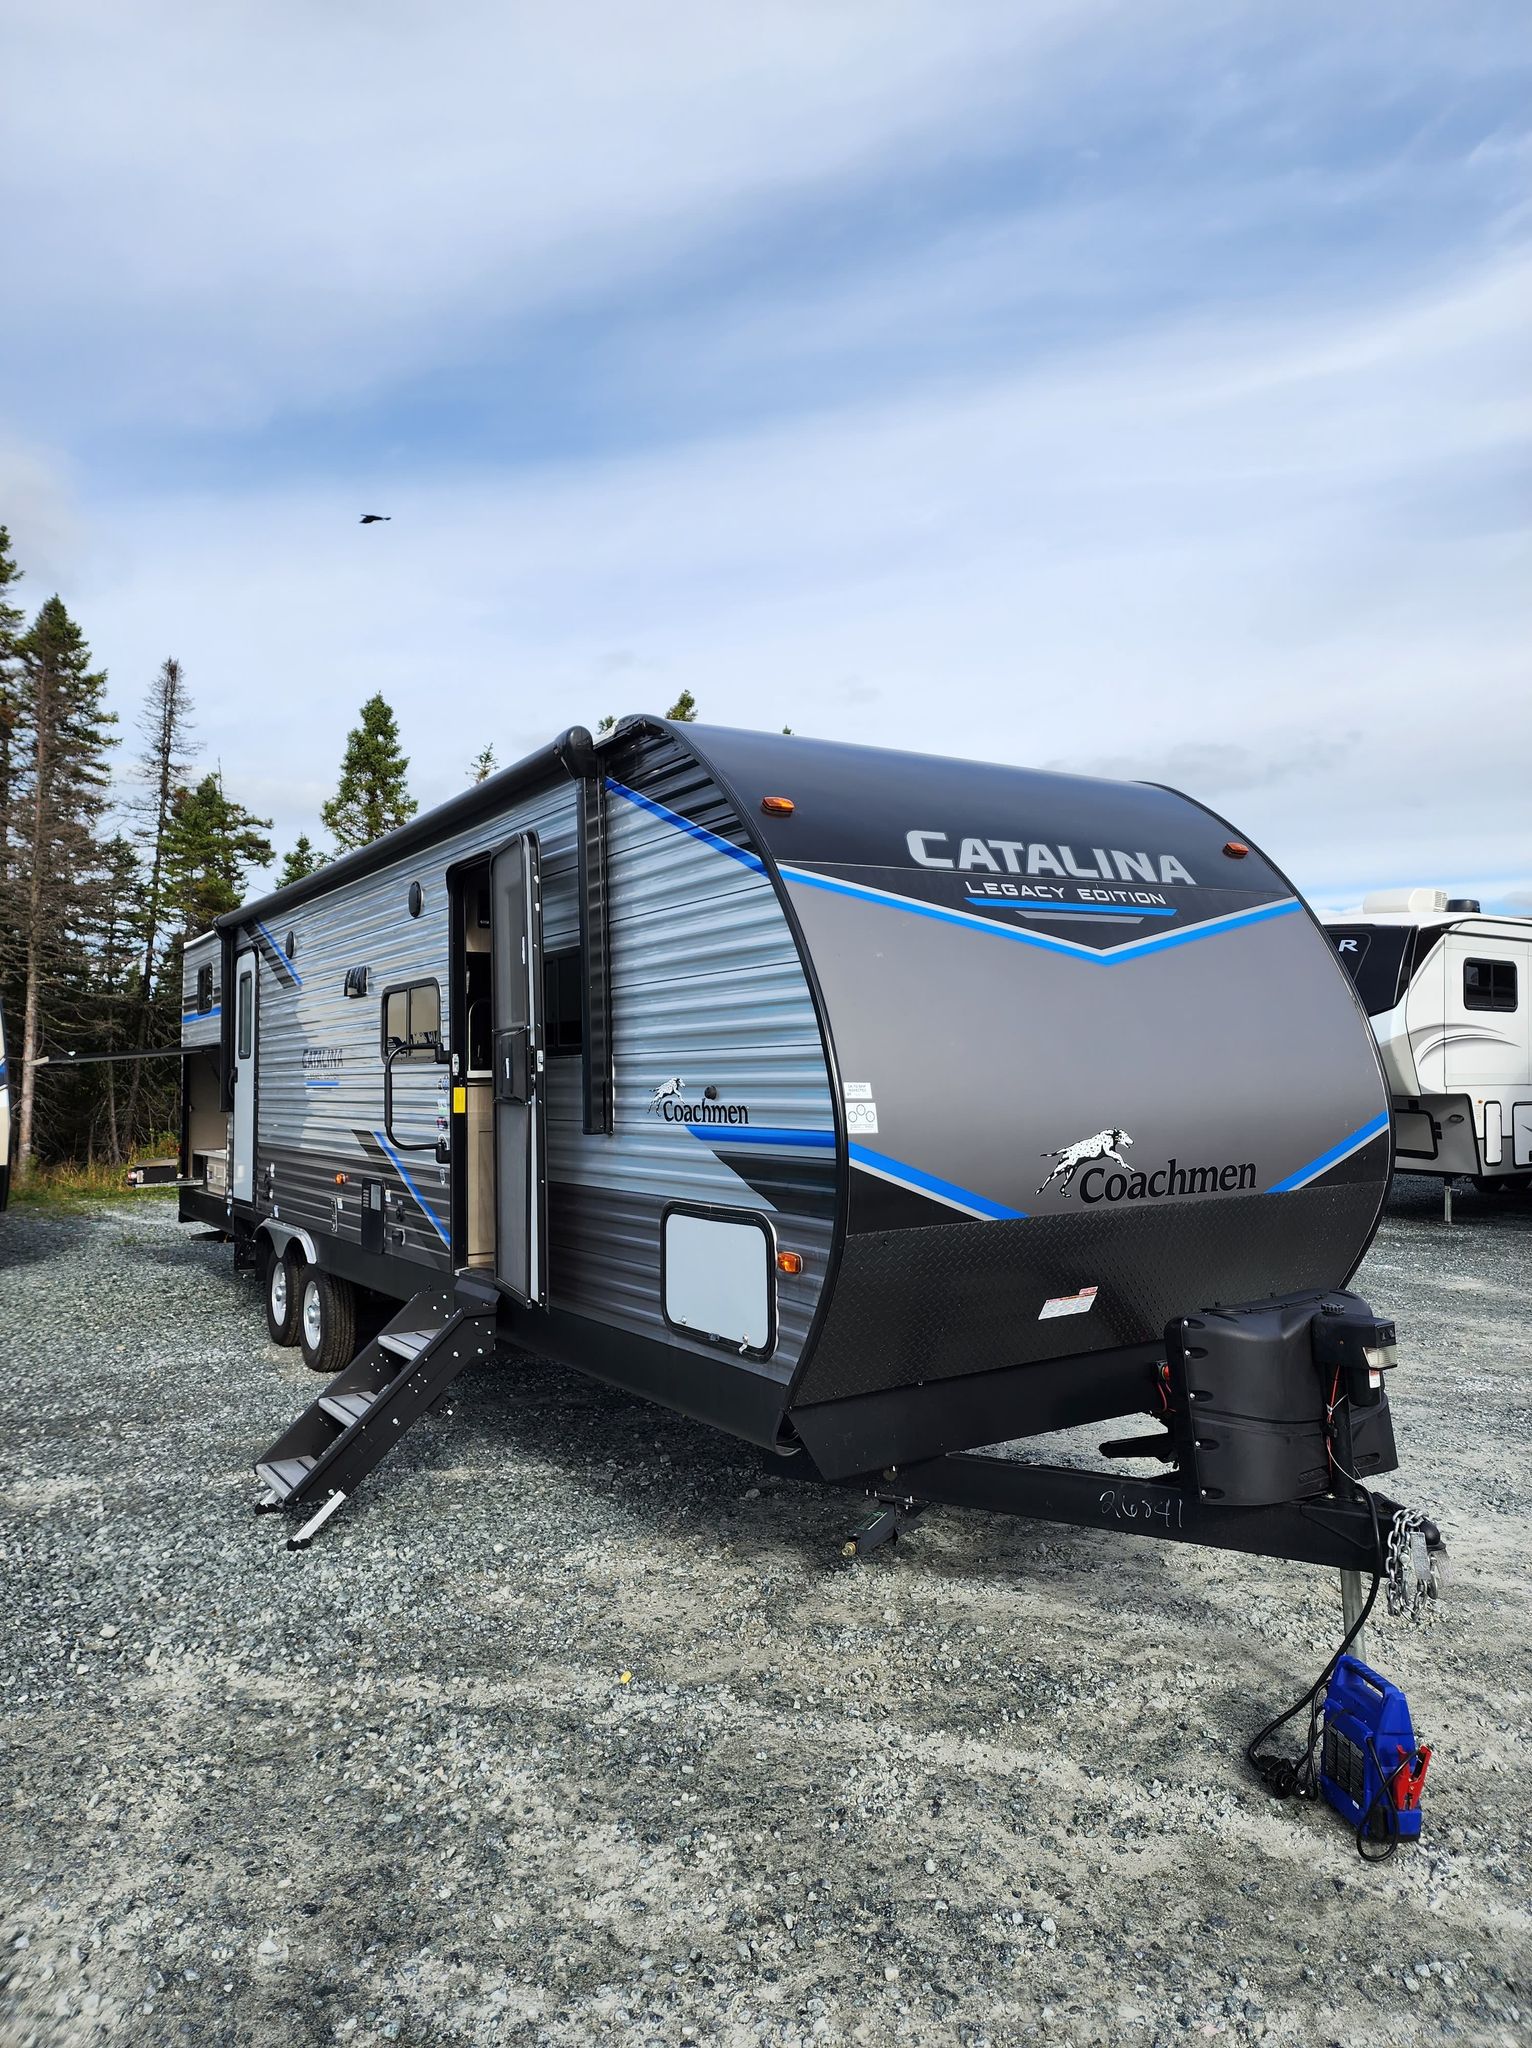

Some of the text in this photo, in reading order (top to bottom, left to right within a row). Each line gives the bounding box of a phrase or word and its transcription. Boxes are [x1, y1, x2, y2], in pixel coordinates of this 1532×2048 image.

[905, 829, 1197, 886] CATALINA
[965, 880, 1167, 905] LEGACY EDITION
[302, 1048, 344, 1069] CATALINA
[663, 1098, 749, 1124] Coachmen
[1079, 1159, 1257, 1204] Coachmen
